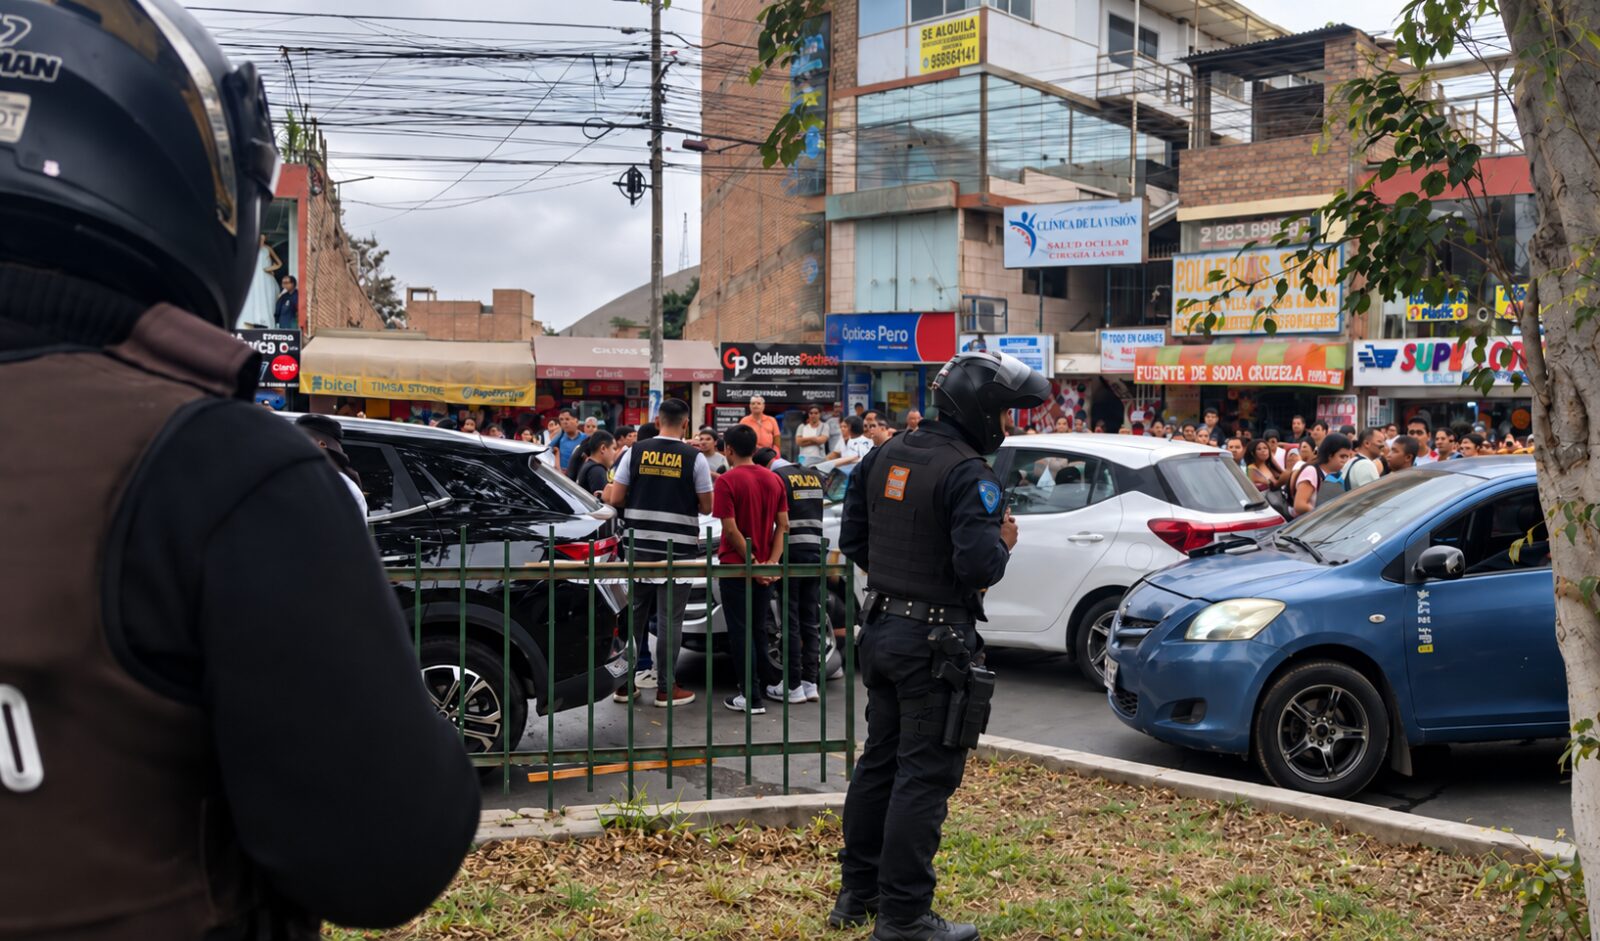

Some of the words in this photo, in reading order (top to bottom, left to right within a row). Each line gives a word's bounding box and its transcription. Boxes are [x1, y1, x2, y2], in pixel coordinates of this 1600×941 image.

[922, 28, 932, 40] SE
[1037, 217, 1075, 231] CLÍNICA
[1076, 218, 1089, 229] DE
[1090, 217, 1102, 228] LA
[1102, 212, 1137, 227] VISIÓN
[1047, 241, 1082, 249] SALUD
[1085, 239, 1129, 247] OCULAR
[842, 323, 876, 343] Ópticas
[878, 325, 908, 342] Pero
[1128, 333, 1136, 343] EN
[1138, 332, 1163, 343] CARNES
[1136, 365, 1185, 381] FUENTE
[1191, 366, 1207, 381] DE
[1212, 365, 1243, 381] SODA
[324, 379, 357, 392] bitel
[369, 382, 404, 393] TIMSA
[408, 384, 445, 395] STORE
[641, 451, 682, 468] POLICIA
[788, 474, 822, 488] POLICIA
